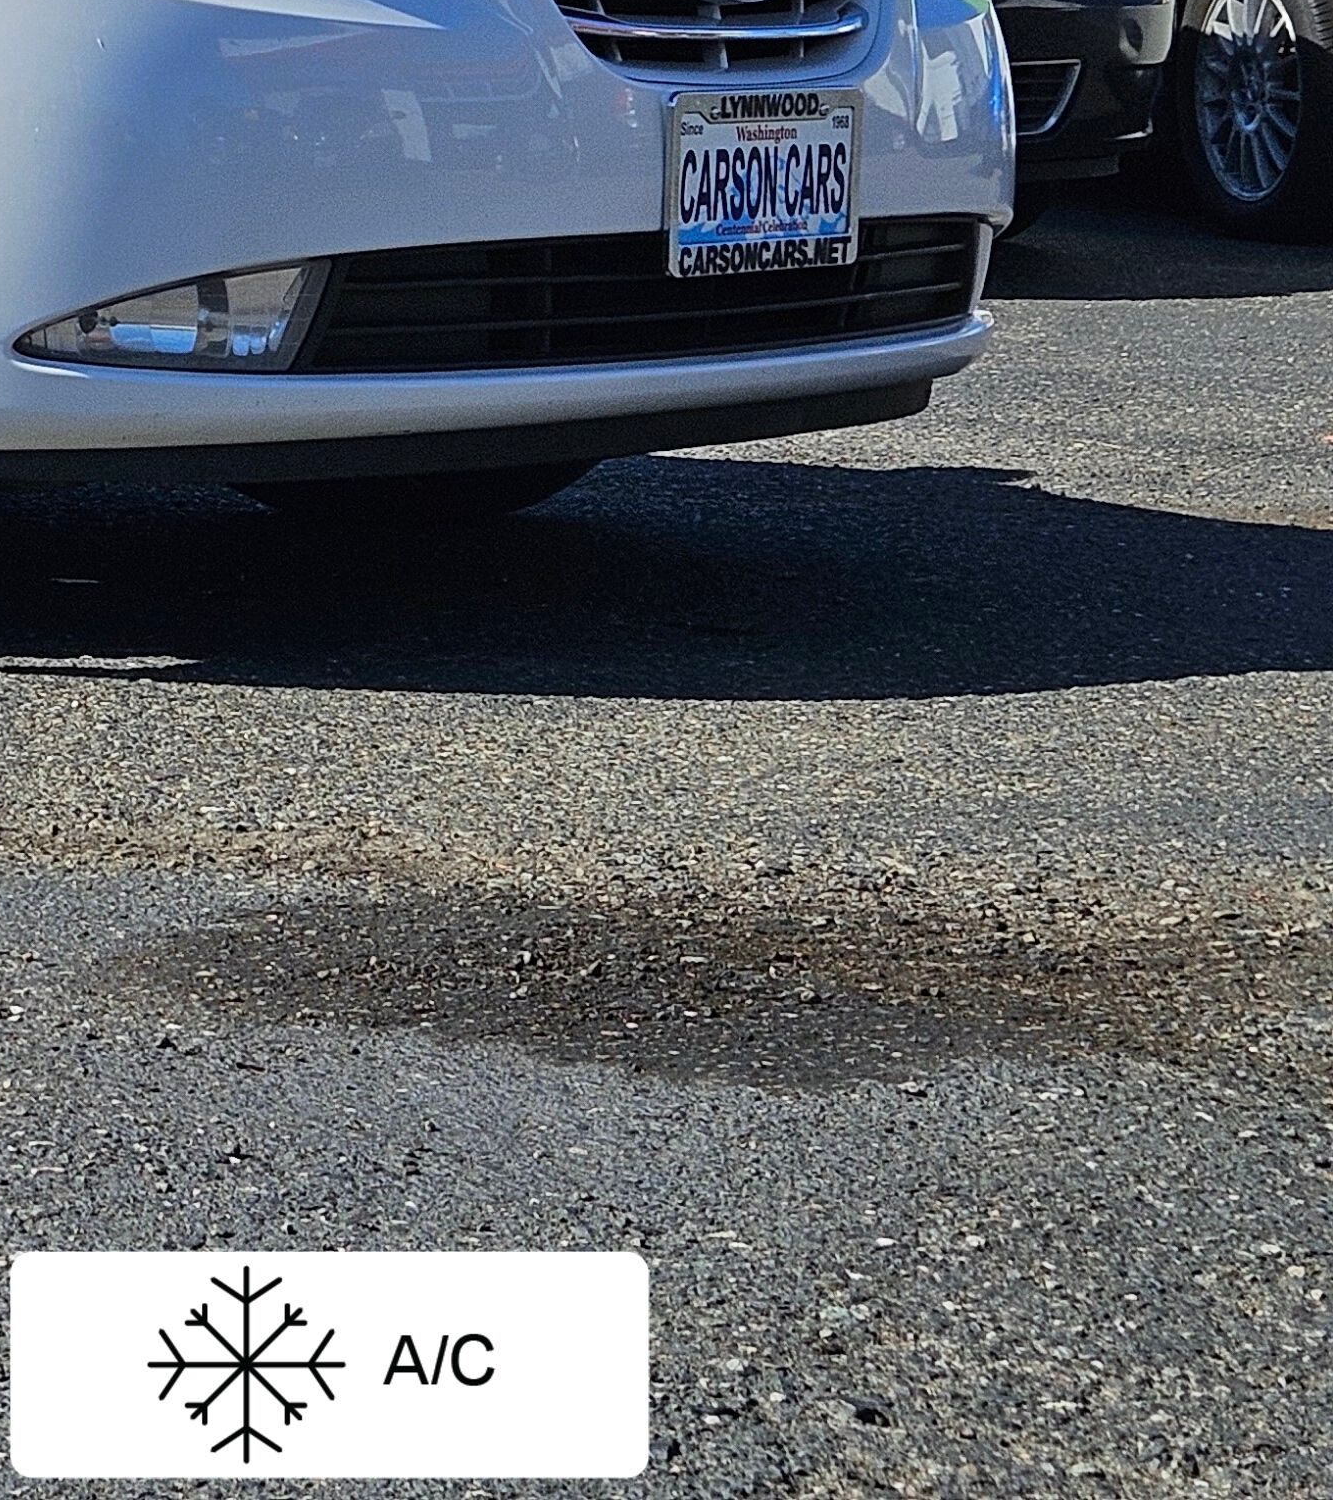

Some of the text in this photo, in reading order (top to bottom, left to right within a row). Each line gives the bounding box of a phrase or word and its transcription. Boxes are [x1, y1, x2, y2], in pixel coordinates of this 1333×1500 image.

[720, 93, 820, 119] LYNNWOOD
[680, 122, 704, 136] Since
[736, 125, 798, 144] Washington
[680, 141, 847, 224] CARSON CARS
[679, 235, 852, 276] CARSONCARS.NET
